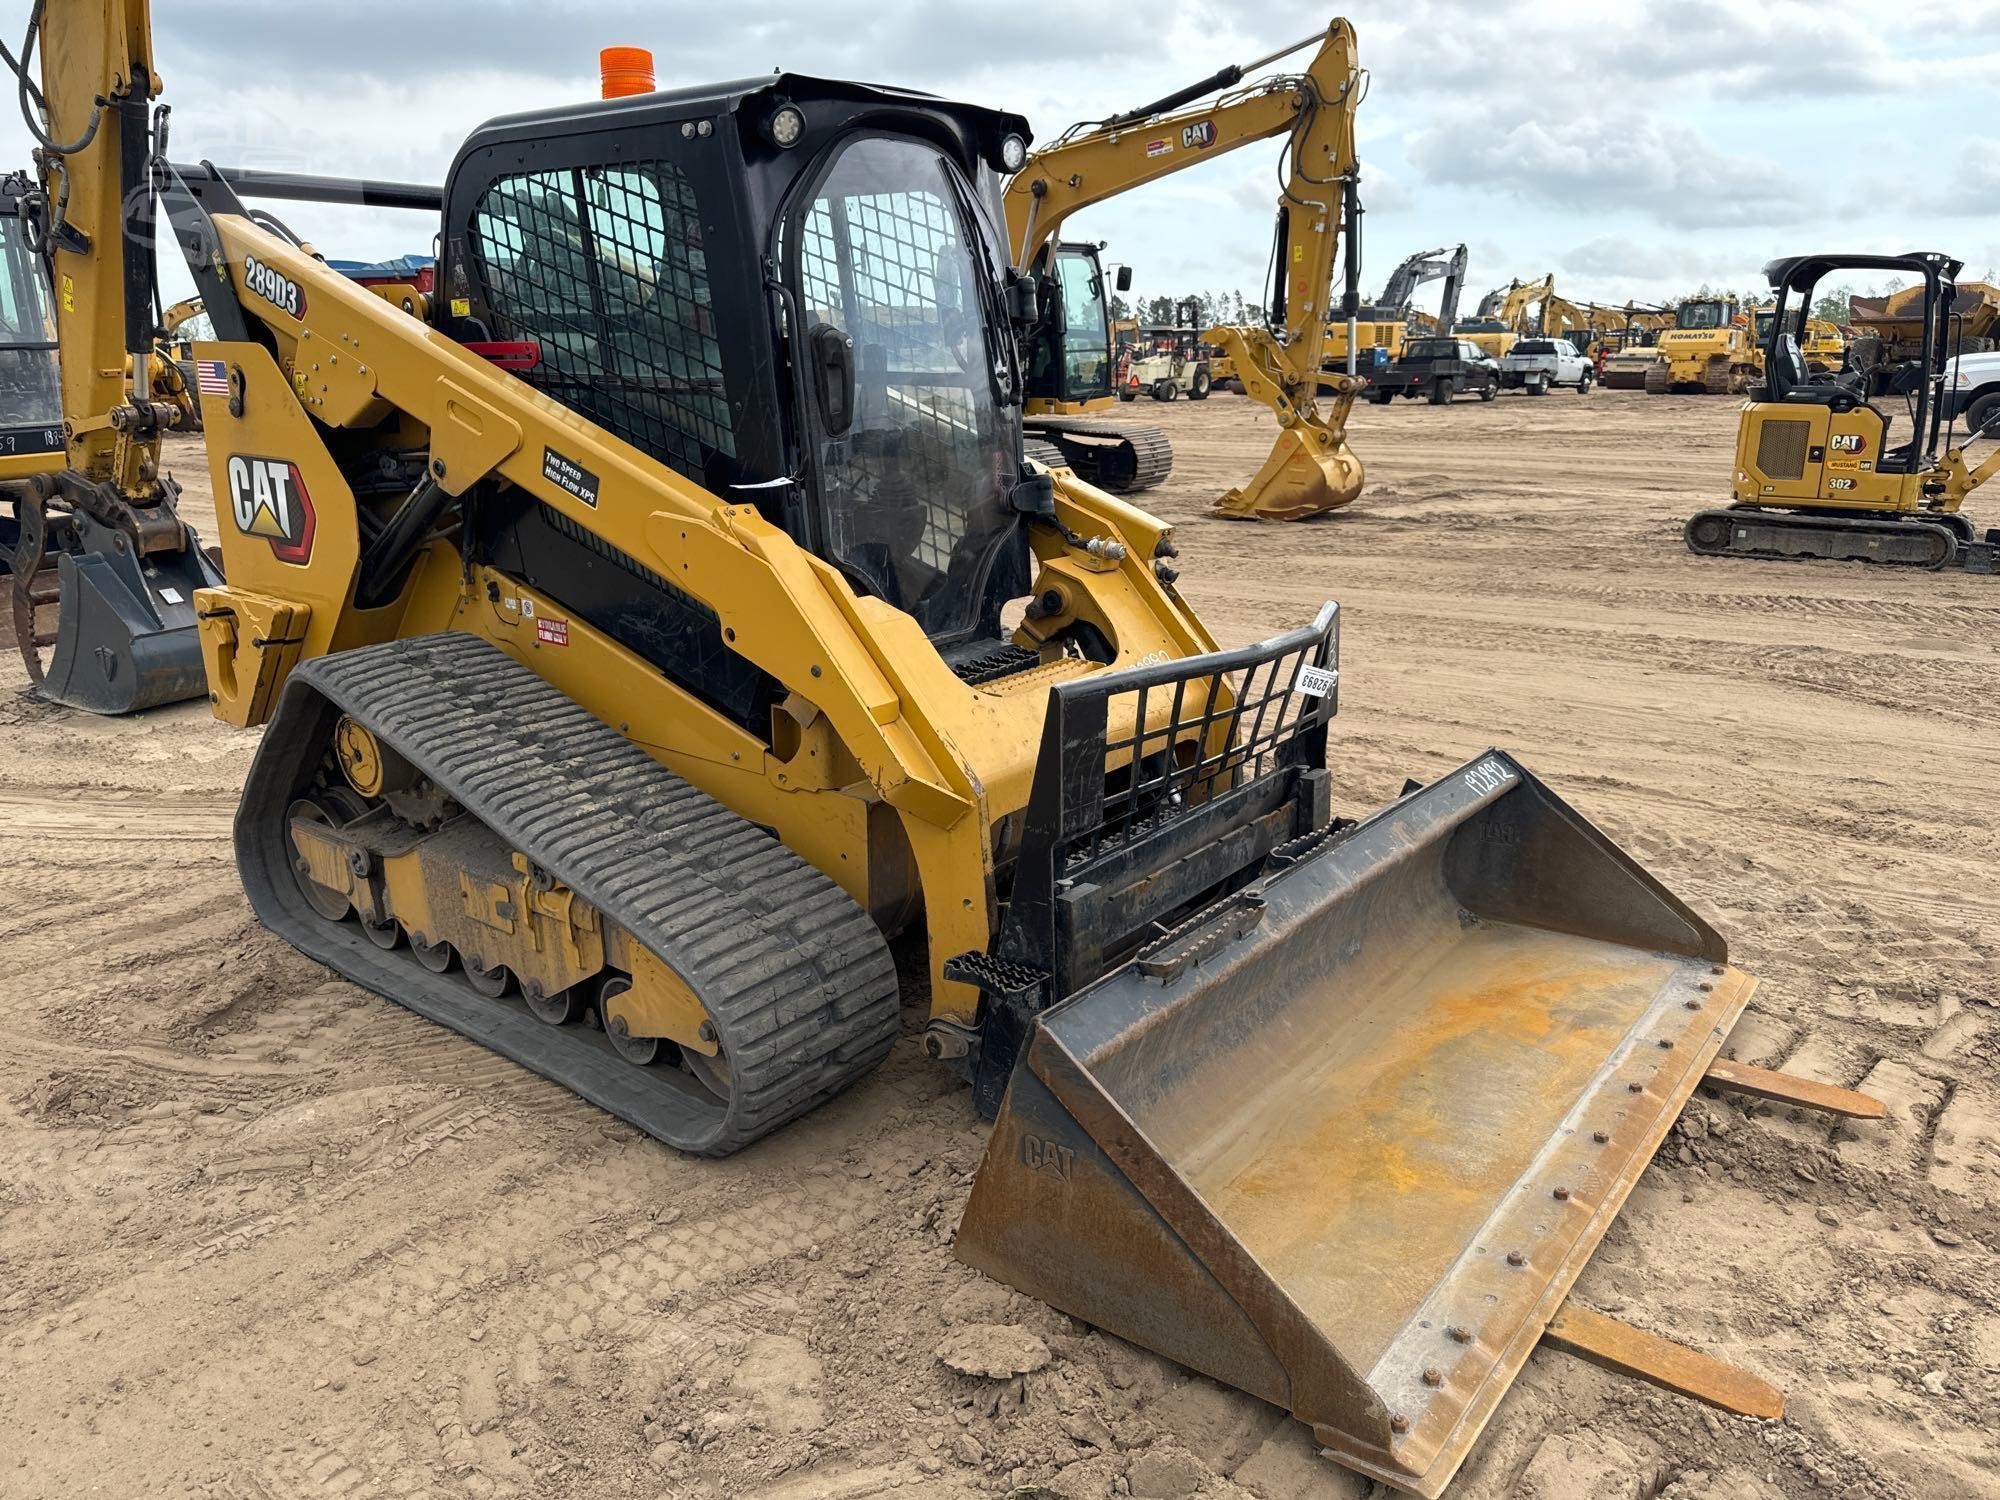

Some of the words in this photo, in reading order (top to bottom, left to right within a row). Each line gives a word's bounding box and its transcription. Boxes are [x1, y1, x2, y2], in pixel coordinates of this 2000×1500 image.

[1182, 121, 1209, 148] CAT
[245, 256, 297, 315] 289D3
[1670, 332, 1715, 340] KOMATSU
[1831, 435, 1859, 450] CAT
[560, 461, 582, 480] SPEED
[1829, 478, 1852, 490] 302
[228, 456, 291, 539] CAT
[545, 466, 561, 482] HIGH
[561, 476, 579, 493] FLOW
[580, 487, 595, 503] XPS
[1024, 1134, 1074, 1183] CAT
